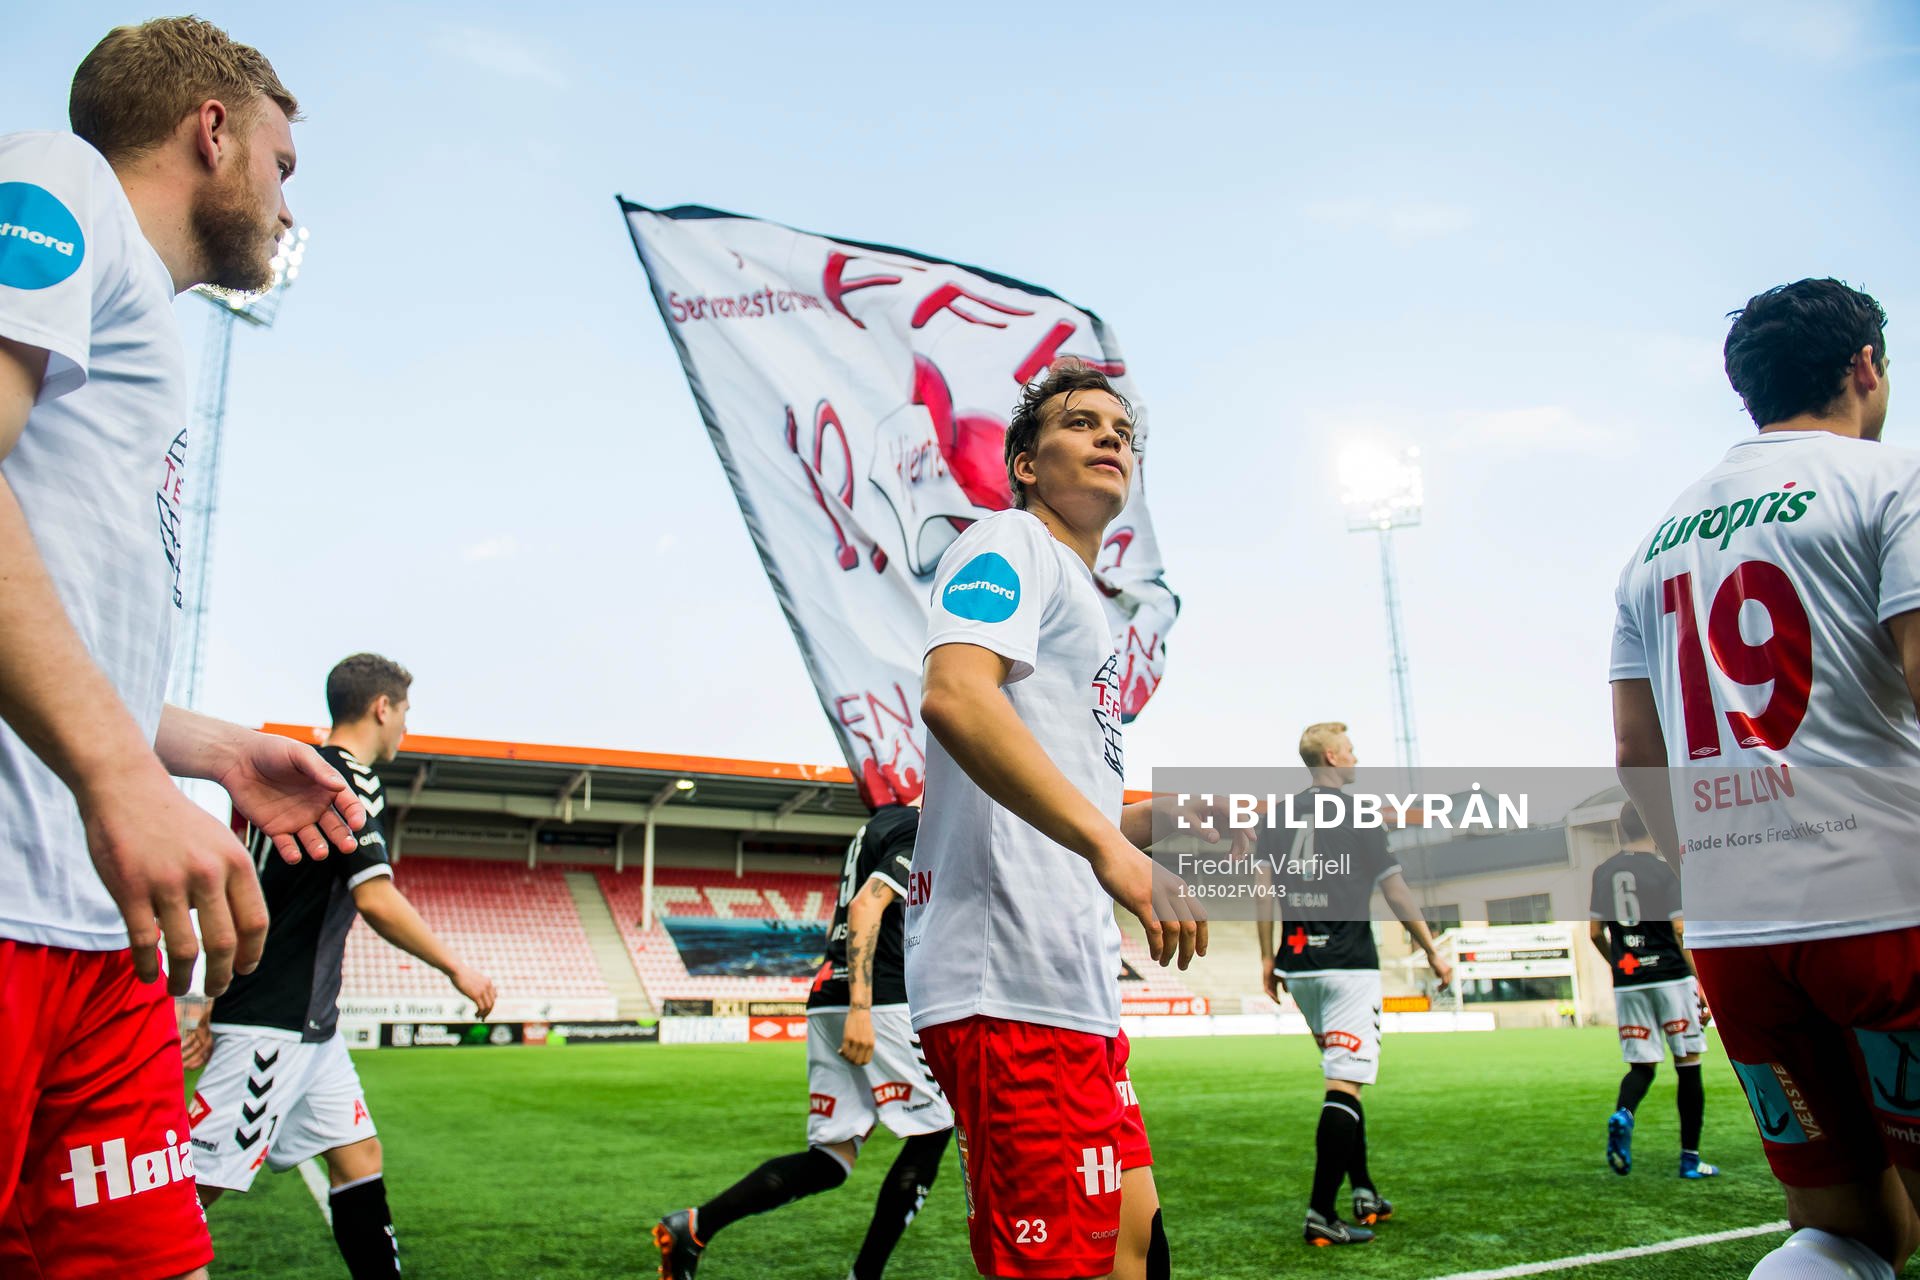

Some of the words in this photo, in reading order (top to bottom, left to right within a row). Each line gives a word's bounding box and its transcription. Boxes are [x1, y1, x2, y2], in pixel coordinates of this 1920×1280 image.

[0, 222, 75, 257] tnord
[1644, 481, 1816, 564] Europris
[948, 580, 1016, 601] postnord
[1663, 560, 1813, 761] 19
[1687, 835, 1722, 853] Røde
[1726, 832, 1763, 848] Kors
[1766, 814, 1858, 843] Fredrikstad
[905, 870, 932, 908] EN
[1612, 870, 1641, 927] 6
[1015, 1218, 1048, 1243] 23
